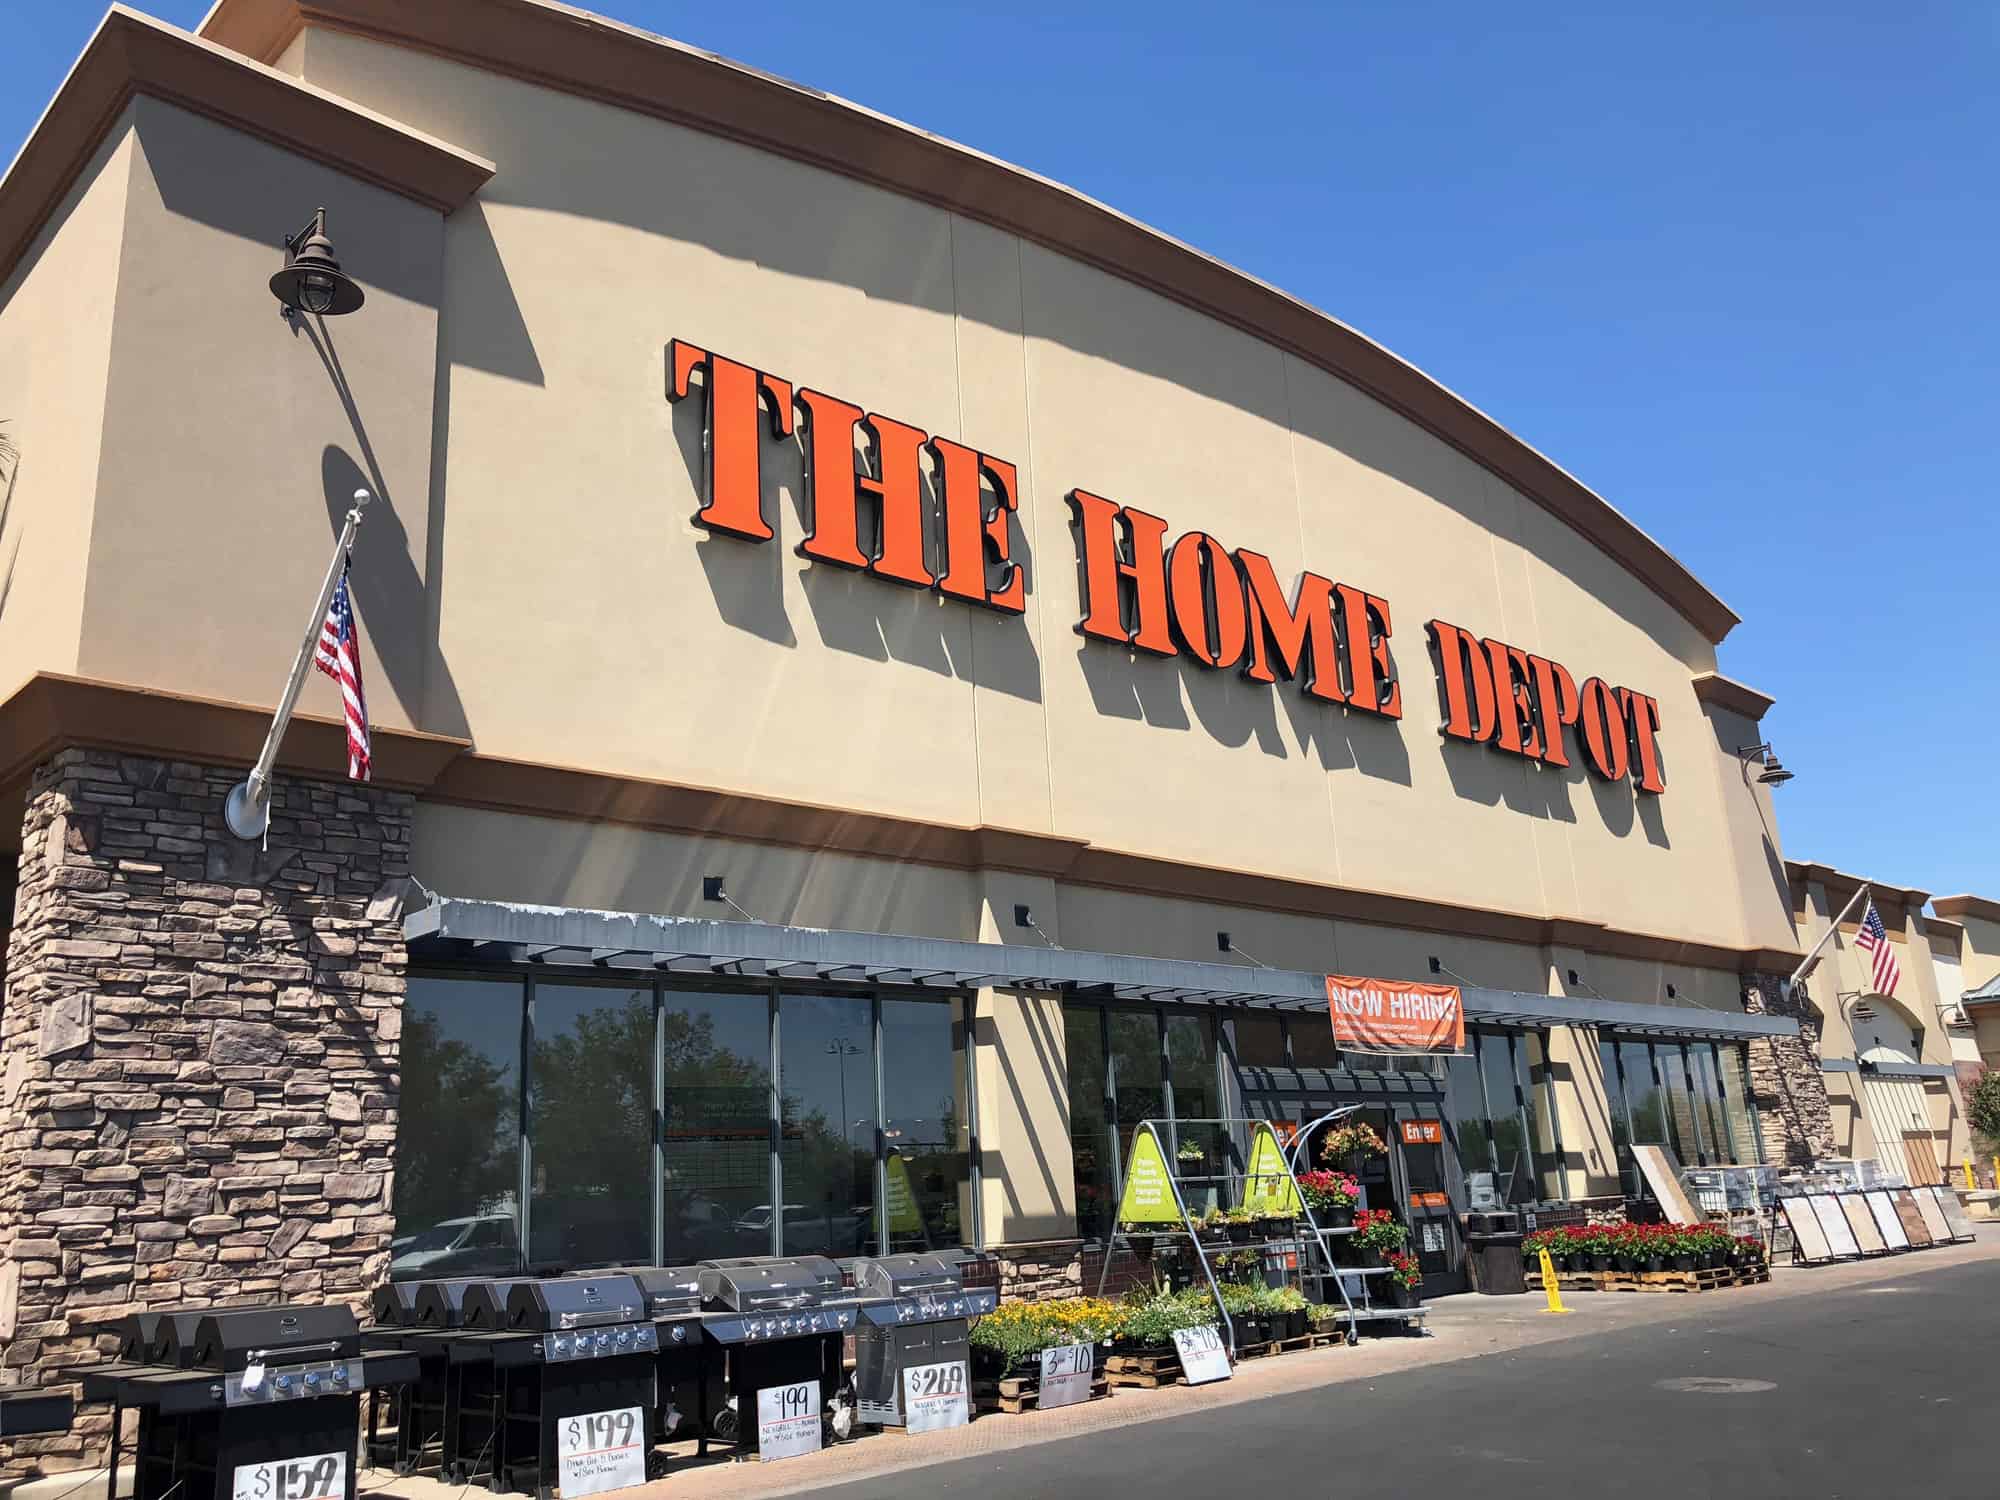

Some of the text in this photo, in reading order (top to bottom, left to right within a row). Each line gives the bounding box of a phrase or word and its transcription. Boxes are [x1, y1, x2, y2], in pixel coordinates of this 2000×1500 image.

[666, 338, 1665, 794] THE HOME DEPOT
[1332, 986, 1457, 1021] NOW HIRING
[1406, 1123, 1436, 1140] Enter
[911, 1366, 962, 1395] $269
[774, 1386, 808, 1420] $199
[568, 1412, 635, 1451] $199
[254, 1457, 338, 1500] $159
